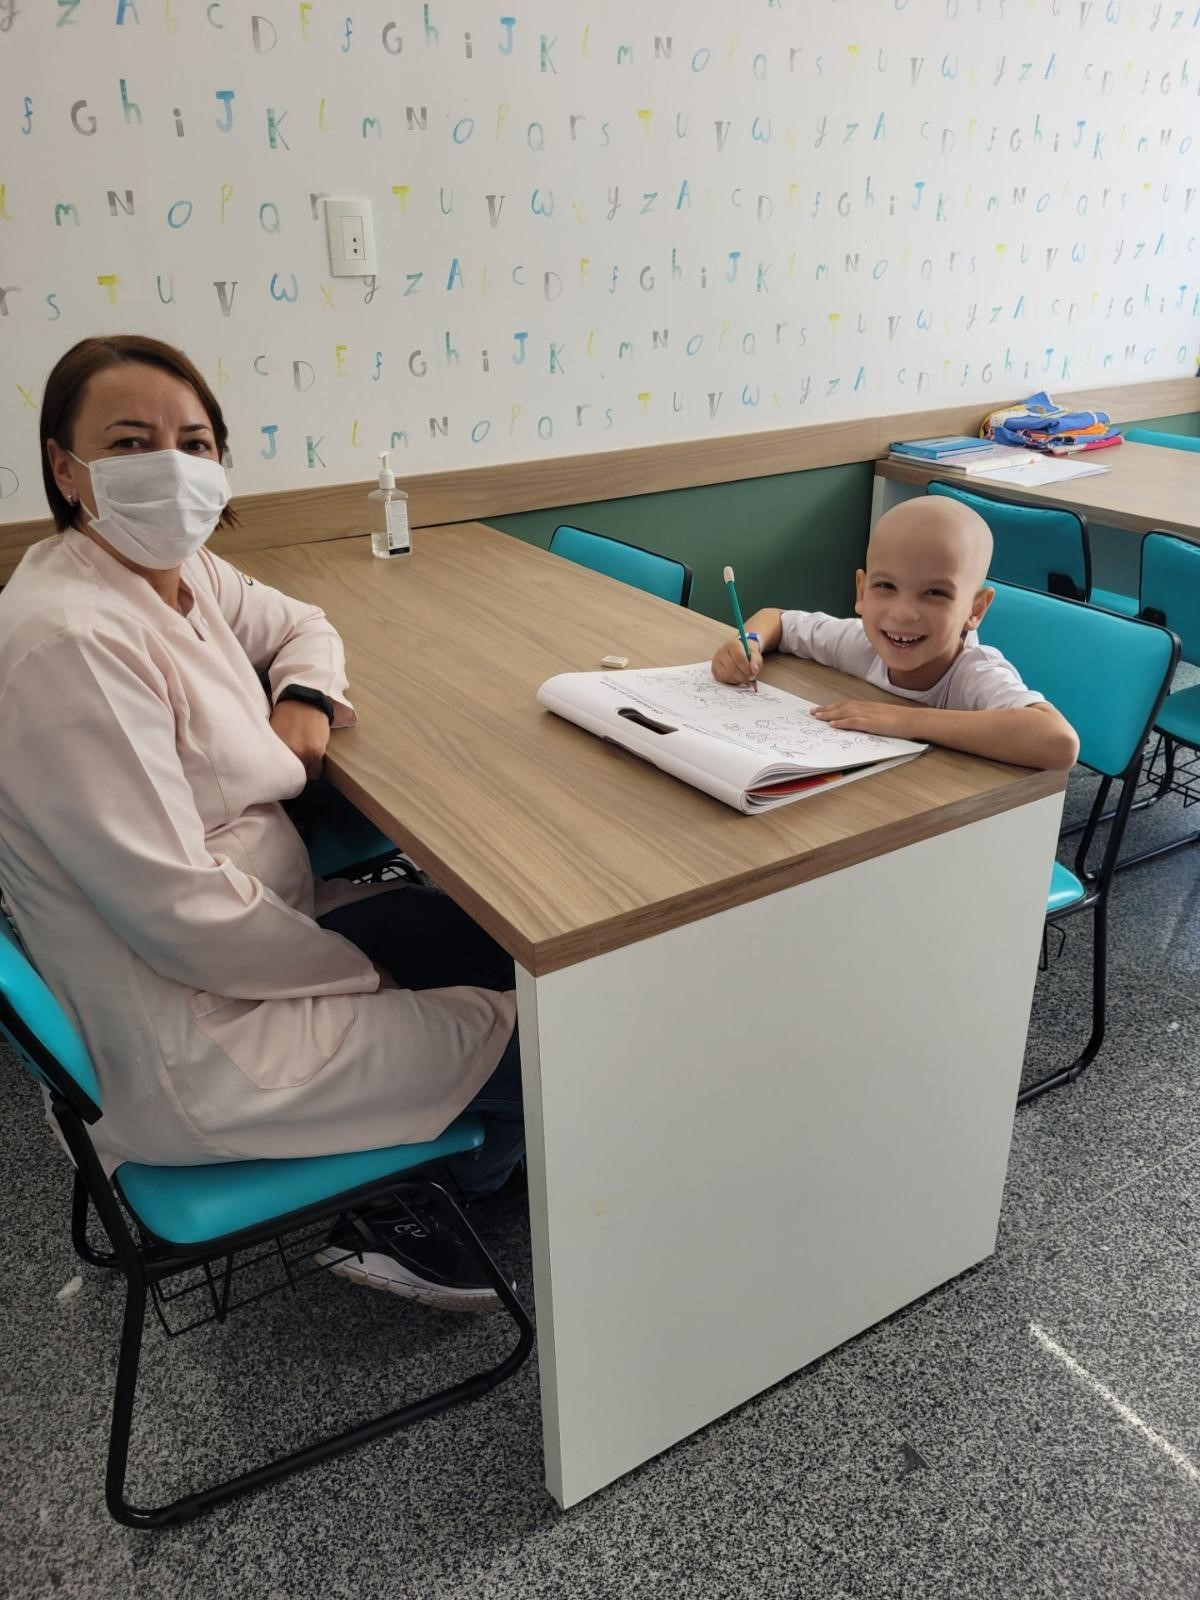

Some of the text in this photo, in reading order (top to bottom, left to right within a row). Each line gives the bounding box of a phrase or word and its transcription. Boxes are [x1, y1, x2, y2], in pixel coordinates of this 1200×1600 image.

[251, 16, 277, 54] D
[382, 22, 402, 55] G
[424, 3, 438, 46] h
[464, 32, 472, 59] i
[499, 16, 516, 54] J
[71, 100, 97, 136] G
[119, 79, 141, 123] h
[173, 108, 184, 137] i
[215, 90, 235, 131] J
[267, 108, 290, 151] K
[406, 107, 427, 130] N
[107, 190, 134, 216] N
[391, 185, 411, 212] T
[97, 273, 120, 304] T
[446, 258, 463, 291] A
[293, 361, 315, 391] D
[408, 350, 427, 377] G
[445, 331, 459, 365] h
[482, 350, 489, 372] i
[261, 425, 278, 459] J
[306, 436, 326, 468] K
[429, 417, 448, 437] N
